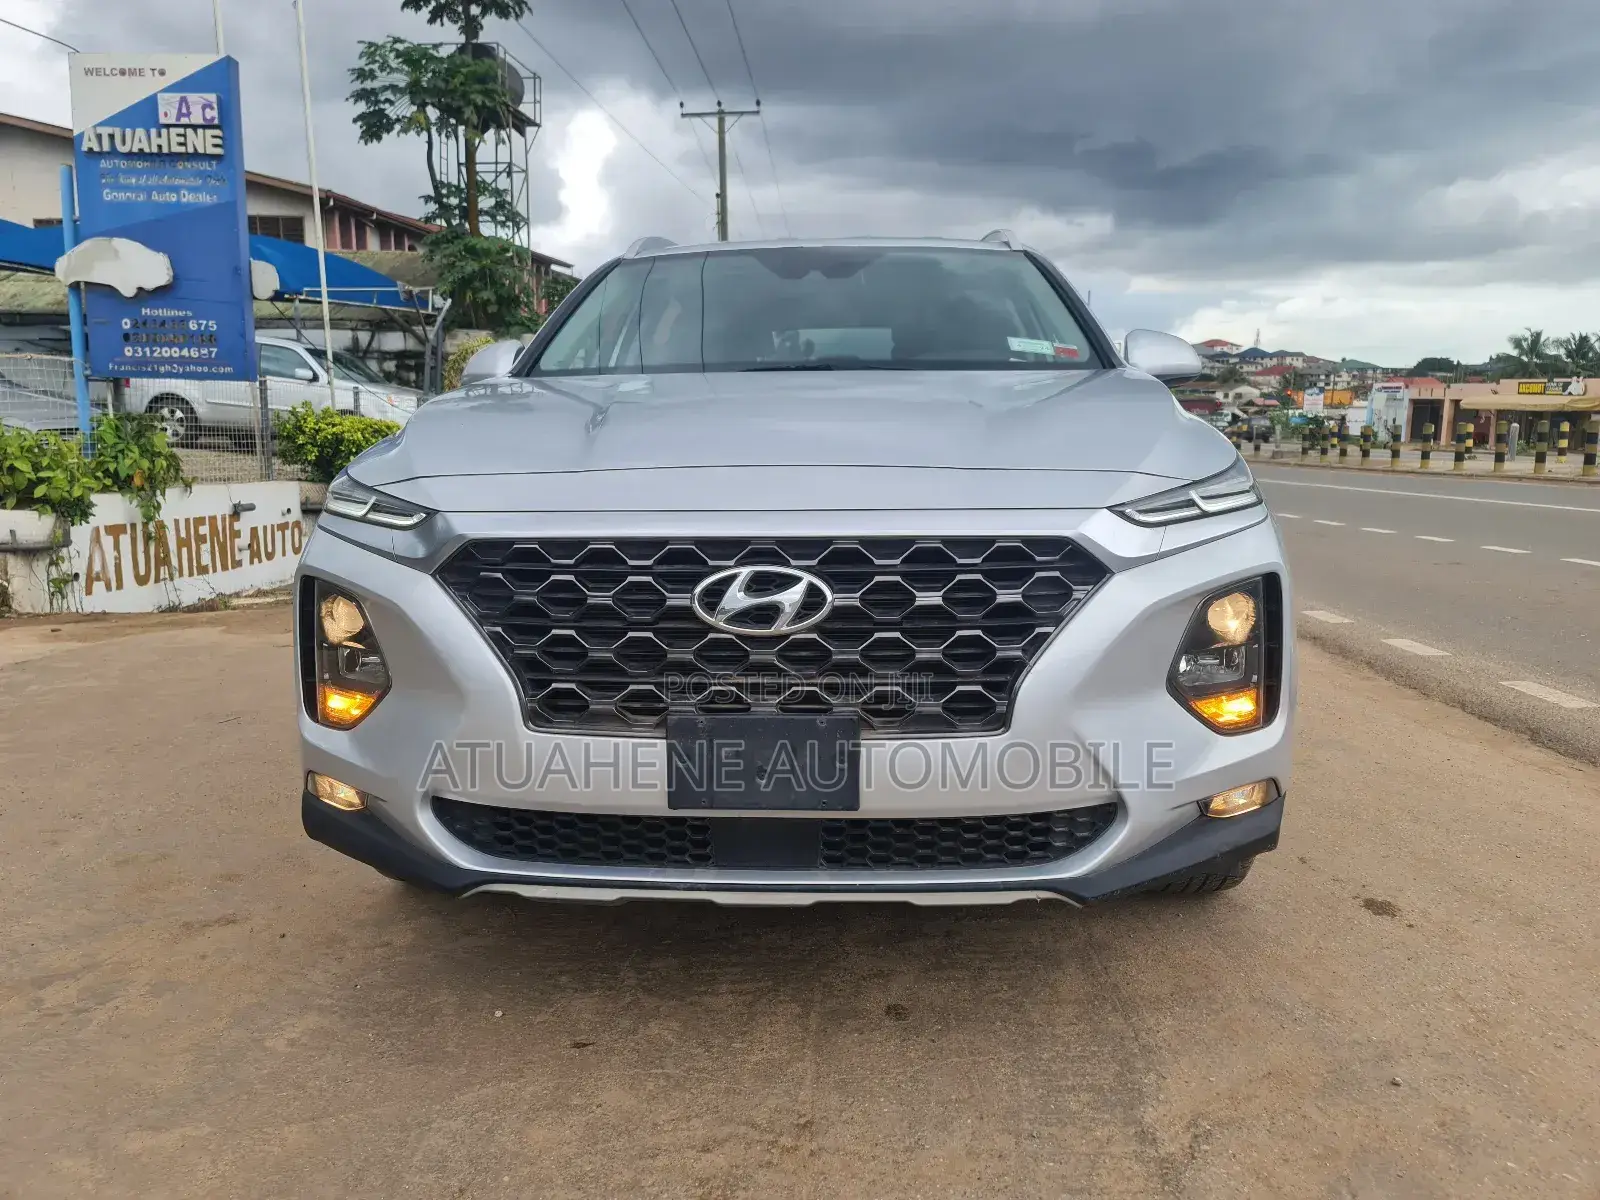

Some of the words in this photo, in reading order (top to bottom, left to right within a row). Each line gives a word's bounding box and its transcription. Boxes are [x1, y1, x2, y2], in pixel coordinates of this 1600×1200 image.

[83, 67, 146, 78] WELCOME
[150, 68, 167, 77] TO
[81, 126, 224, 155] ATUAHENE
[151, 190, 178, 203] Auto
[141, 307, 193, 317] Hotlines
[124, 346, 218, 359] 0312004687
[85, 513, 243, 596] ATUAHENE
[249, 519, 303, 565] AUTO
